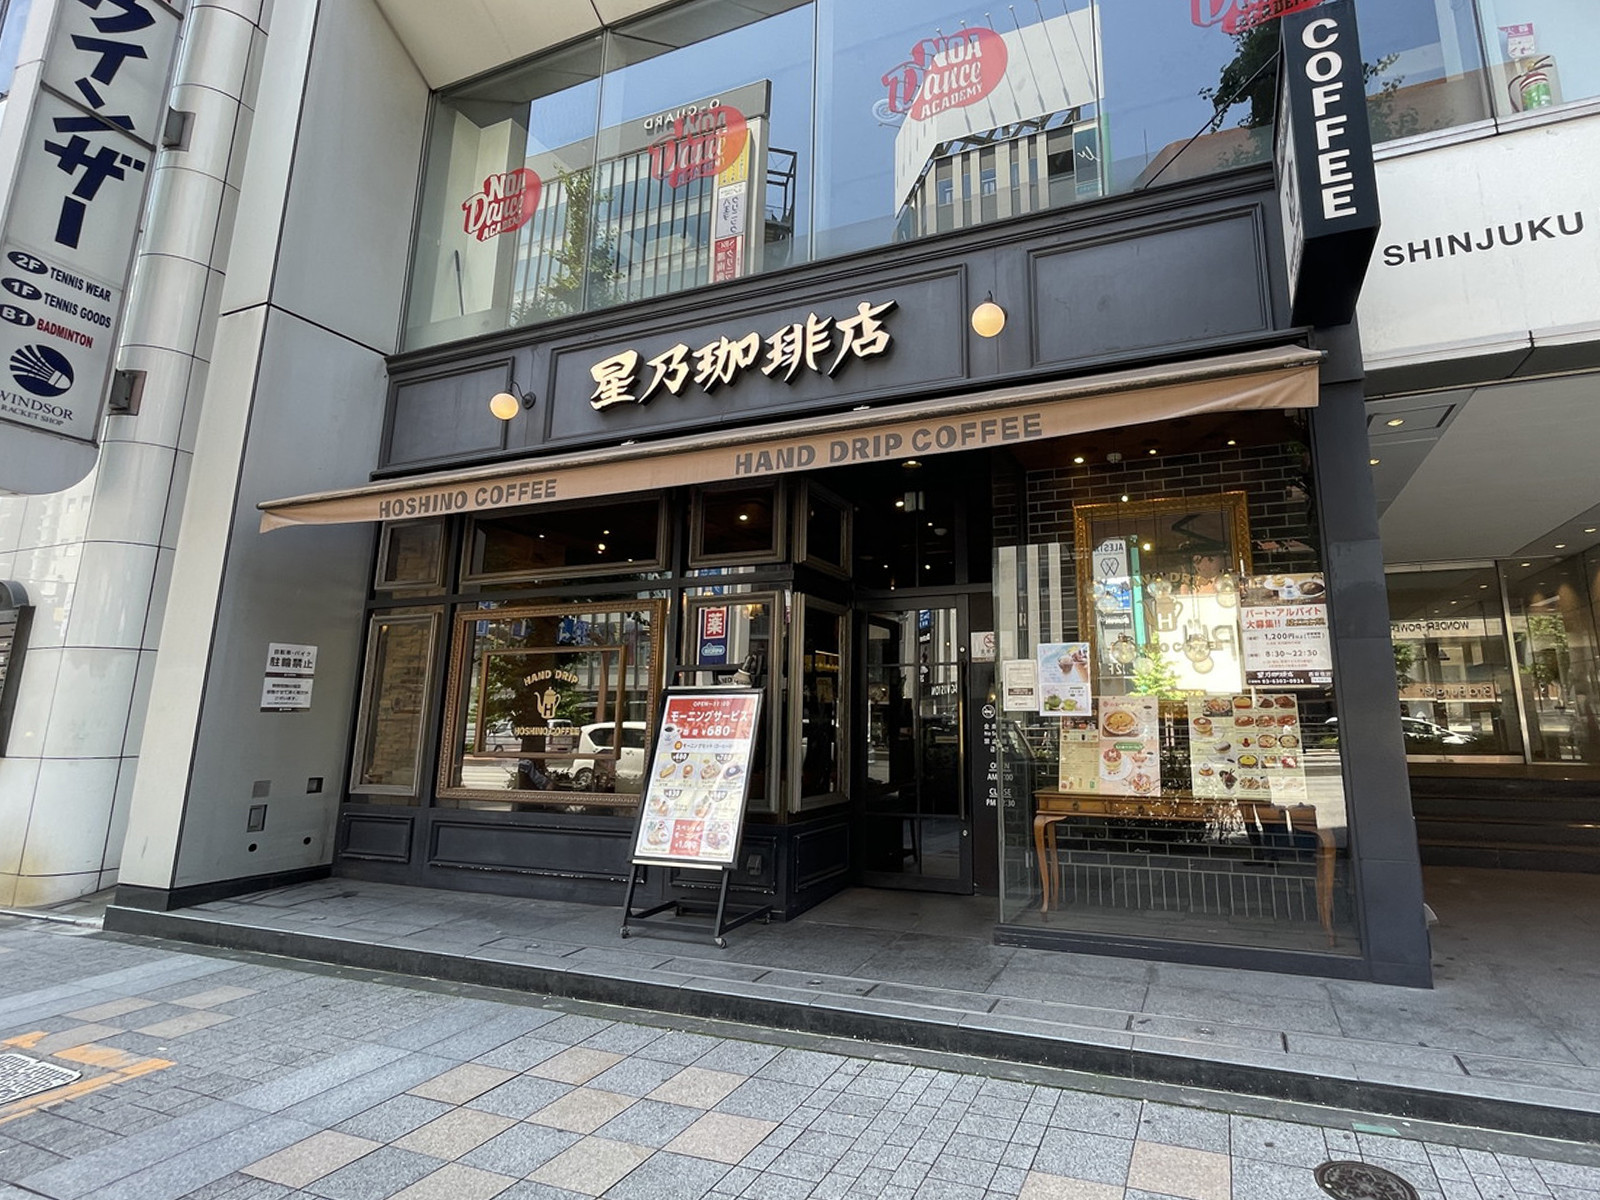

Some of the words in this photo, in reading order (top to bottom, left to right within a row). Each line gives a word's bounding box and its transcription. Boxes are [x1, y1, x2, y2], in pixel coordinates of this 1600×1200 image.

[921, 83, 982, 119] ACADEMY
[1301, 18, 1357, 220] COFFEE
[1383, 211, 1584, 267] SHINJUKU
[15, 254, 42, 271] 2F
[10, 281, 35, 297] 1F
[50, 267, 84, 291] TENNIS
[86, 282, 112, 302] WEAR
[2, 306, 28, 325] B1
[44, 292, 78, 316] TENNIS
[80, 307, 112, 329] GOODS
[37, 318, 94, 349] BADMINTON
[589, 300, 898, 411] 星乃珈琲店
[734, 445, 816, 475] HAND
[829, 433, 903, 463] DRIP
[911, 413, 1042, 451] COFFEE
[379, 490, 468, 518] HOSHINO
[475, 479, 557, 507] COFFEE
[523, 670, 551, 687] HAND
[554, 669, 579, 686] DRIP
[514, 726, 549, 737] HOSHINO
[671, 710, 748, 723] モーニングサービス
